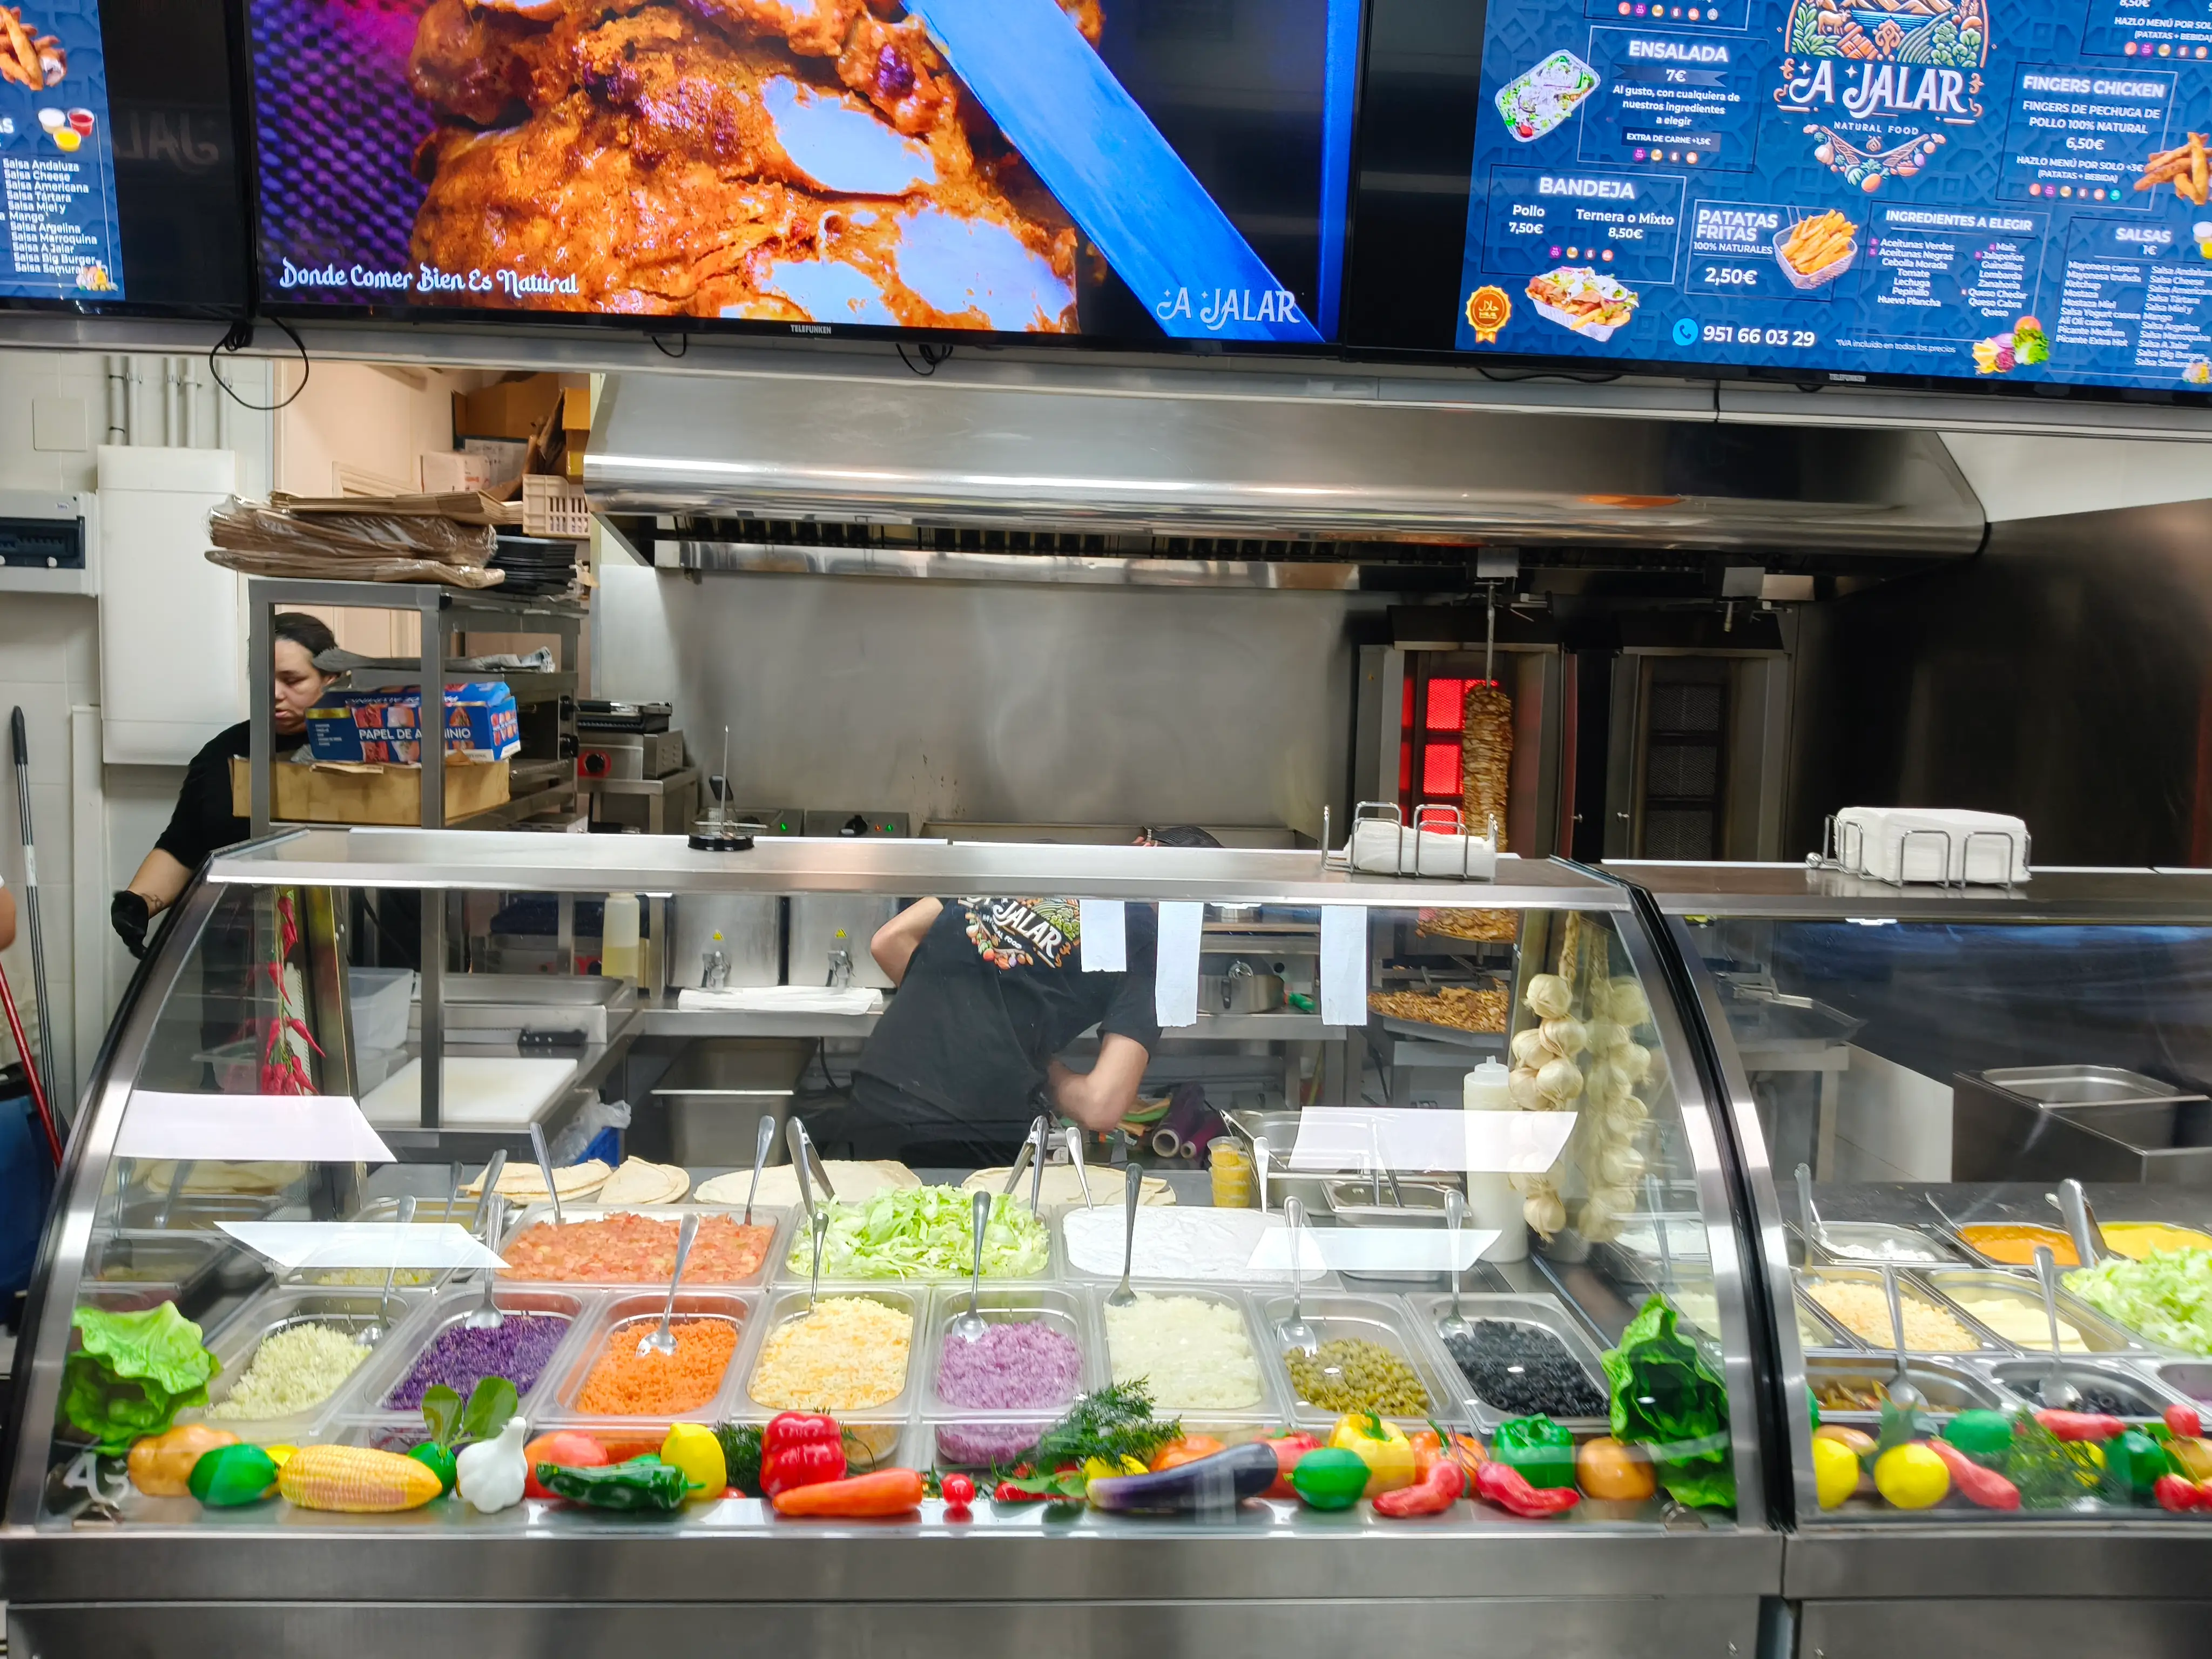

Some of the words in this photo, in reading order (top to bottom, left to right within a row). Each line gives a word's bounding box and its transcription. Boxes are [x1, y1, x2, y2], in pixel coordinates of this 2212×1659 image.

[2114, 17, 2145, 26] HAZLO
[2146, 18, 2173, 28] MENÚ
[2174, 20, 2194, 28] POR
[2195, 21, 2212, 30] SOL
[1629, 41, 1729, 62] ENSALADA
[1666, 69, 1687, 82] 7€
[1789, 60, 1835, 104] A
[1842, 63, 1967, 119] JALAR
[2023, 75, 2090, 94] FINGERS
[2093, 80, 2164, 98] CHICKEN
[1613, 85, 1623, 95] Al
[1625, 86, 1655, 97] gusto,
[1657, 89, 1674, 98] con
[1676, 90, 1727, 101] cualquiera
[1728, 92, 1741, 102] de
[1622, 100, 1664, 110] nuestros
[1666, 101, 1726, 114] ingredientes
[2023, 100, 2069, 114] FINGERS
[2071, 104, 2087, 114] DE
[2089, 105, 2142, 118] PECHUGA
[2144, 109, 2161, 119] DE
[1664, 116, 1692, 127] elegir
[2029, 117, 2066, 129] POLLO
[2068, 119, 2094, 130] 100%
[2096, 121, 2148, 134] NATURAL
[1833, 121, 1882, 133] NATURAL
[1887, 125, 1919, 136] FOOD
[1627, 132, 1651, 142] EXTRA
[1653, 134, 1663, 143] DE
[1664, 135, 1691, 145] CARNE
[2066, 137, 2105, 151] 6,50€
[3, 158, 29, 170] Salsa
[32, 159, 79, 172] Andaluza
[2017, 156, 2048, 166] HAZLO
[2050, 157, 2077, 168] MENÚ
[2079, 160, 2098, 170] POR
[2100, 161, 2124, 171] SOLO
[4, 169, 30, 180] Salsa
[5, 179, 32, 191] Salsa
[1539, 177, 1635, 199] BANDEJA
[6, 190, 32, 201] Salsa
[8, 200, 34, 211] Salsa
[59, 204, 65, 214] y
[1513, 204, 1546, 217] Pollo
[9, 211, 44, 223] Mango
[1576, 208, 1624, 223] Ternera
[1627, 214, 1635, 224] o
[1638, 212, 1675, 226] Mixto
[1698, 208, 1778, 229] PATATAS
[1886, 210, 1976, 227] INGREDIENTES
[1977, 217, 1987, 228] A
[1989, 218, 2032, 231] ELEGIR
[10, 221, 36, 232] Salsa
[1508, 222, 1544, 234] 7,50€
[1608, 227, 1644, 239] 8,50€
[1696, 224, 1757, 242] FRITAS
[11, 231, 37, 242] Salsa
[2115, 227, 2171, 243] SALSAS
[12, 241, 38, 253] Salsa
[1693, 241, 1717, 252] 100%
[1718, 242, 1773, 255] NATURALES
[1880, 238, 1924, 249] Aceitunas
[1925, 241, 1955, 251] Verdes
[2142, 244, 2157, 255] 1€
[14, 252, 39, 262] Salsa
[1879, 248, 1922, 258] Aceitunas
[1923, 251, 1954, 261] Negras
[15, 262, 41, 273] Salsa
[1882, 258, 1914, 267] Cebolla
[1915, 260, 1948, 270] Morada
[280, 257, 347, 288] Donde
[350, 264, 413, 289] Comer
[416, 262, 465, 293] Bien
[468, 268, 492, 293] Es
[496, 268, 579, 299] Natural
[1704, 267, 1758, 286] 2,50€
[1897, 268, 1930, 278] Tomate
[1893, 277, 1931, 288] Lechuga
[1968, 288, 1995, 297] Queso
[1877, 295, 1906, 305] Huevo
[1906, 297, 1941, 307] Plancha
[1968, 298, 1996, 307] Queso
[1156, 287, 1191, 320] A
[1200, 288, 1300, 331] JALAR
[1981, 308, 2009, 317] Queso
[791, 325, 831, 334] TELEFUNKEN
[1703, 325, 1733, 342] 951
[1737, 328, 1761, 343] 66
[1765, 329, 1788, 346] 03
[1792, 331, 1816, 347] 29
[359, 729, 395, 740] PAPEL
[396, 729, 412, 739] DE
[993, 901, 1062, 959] JALAR
